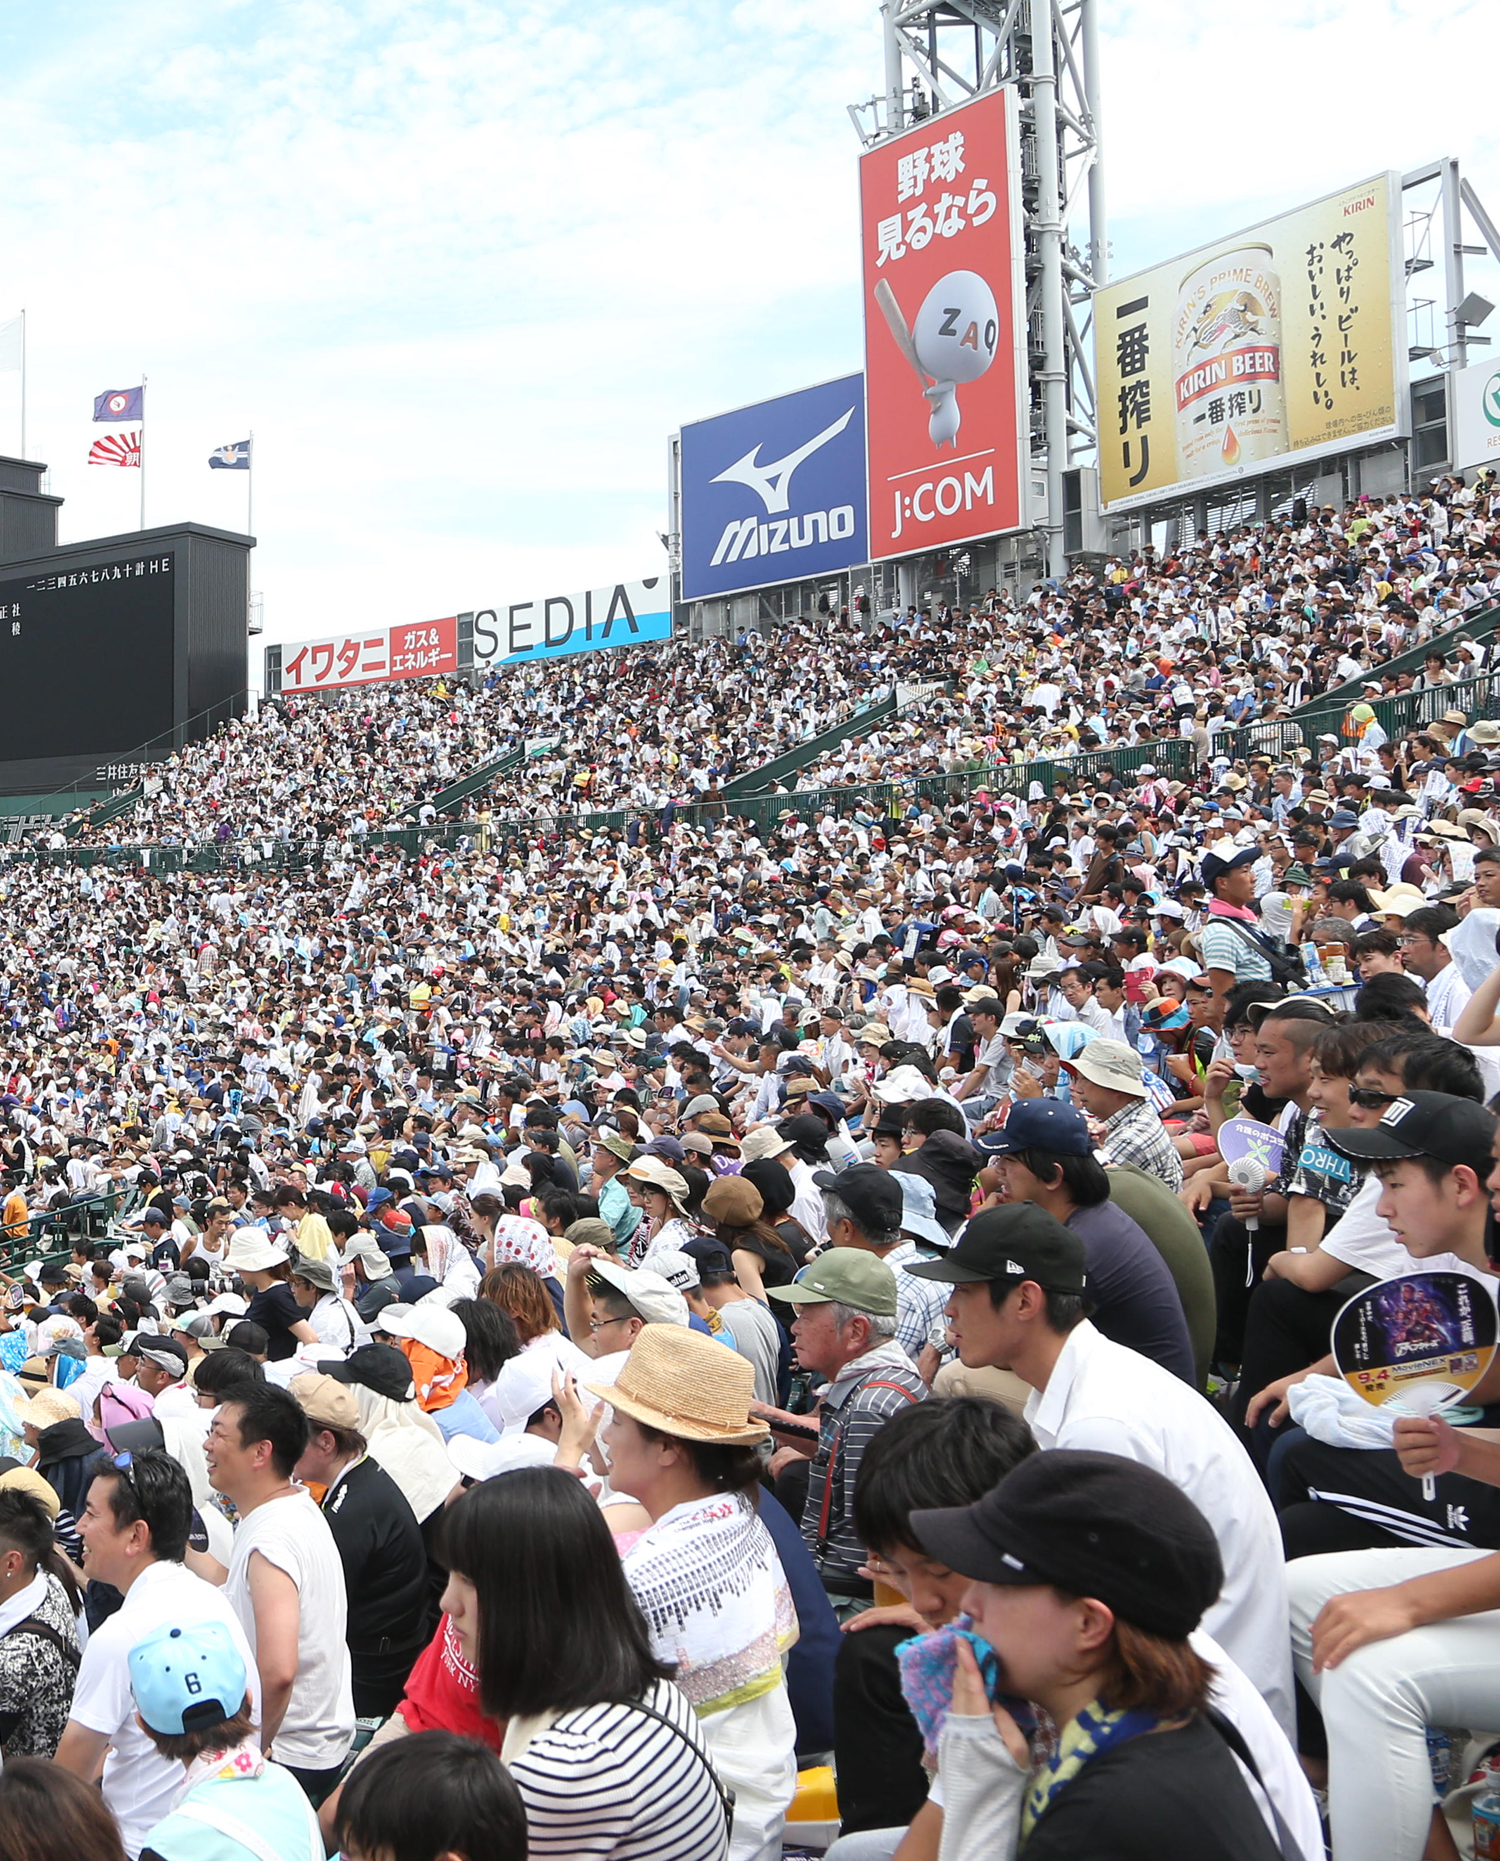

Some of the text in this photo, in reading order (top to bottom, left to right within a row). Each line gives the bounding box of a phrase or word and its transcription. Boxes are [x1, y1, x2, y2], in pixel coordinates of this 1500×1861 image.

[897, 130, 966, 204] 野球
[875, 178, 997, 267] 見るなら
[1343, 196, 1375, 217] KIRIN
[938, 308, 996, 357] ZAQ
[1175, 268, 1278, 350] KIRIN'S PRIME BREW
[1305, 242, 1334, 411] おいしい、うれしい。
[1330, 230, 1361, 391] やっぱりビールは、
[1116, 294, 1153, 488] 一番搾り
[1179, 351, 1276, 404] KIRIN BEER
[1193, 388, 1262, 426] 一番搾り
[891, 465, 994, 539] J:COM
[404, 627, 440, 649] ガス&
[474, 584, 639, 659] SEDIA
[284, 637, 387, 685] イワタニ
[392, 645, 453, 668] エネルギー
[1358, 1369, 1390, 1384] 9.4
[1365, 1383, 1386, 1393] 発売
[1392, 1358, 1447, 1373] MovieNEX
[184, 1672, 202, 1695] 6
